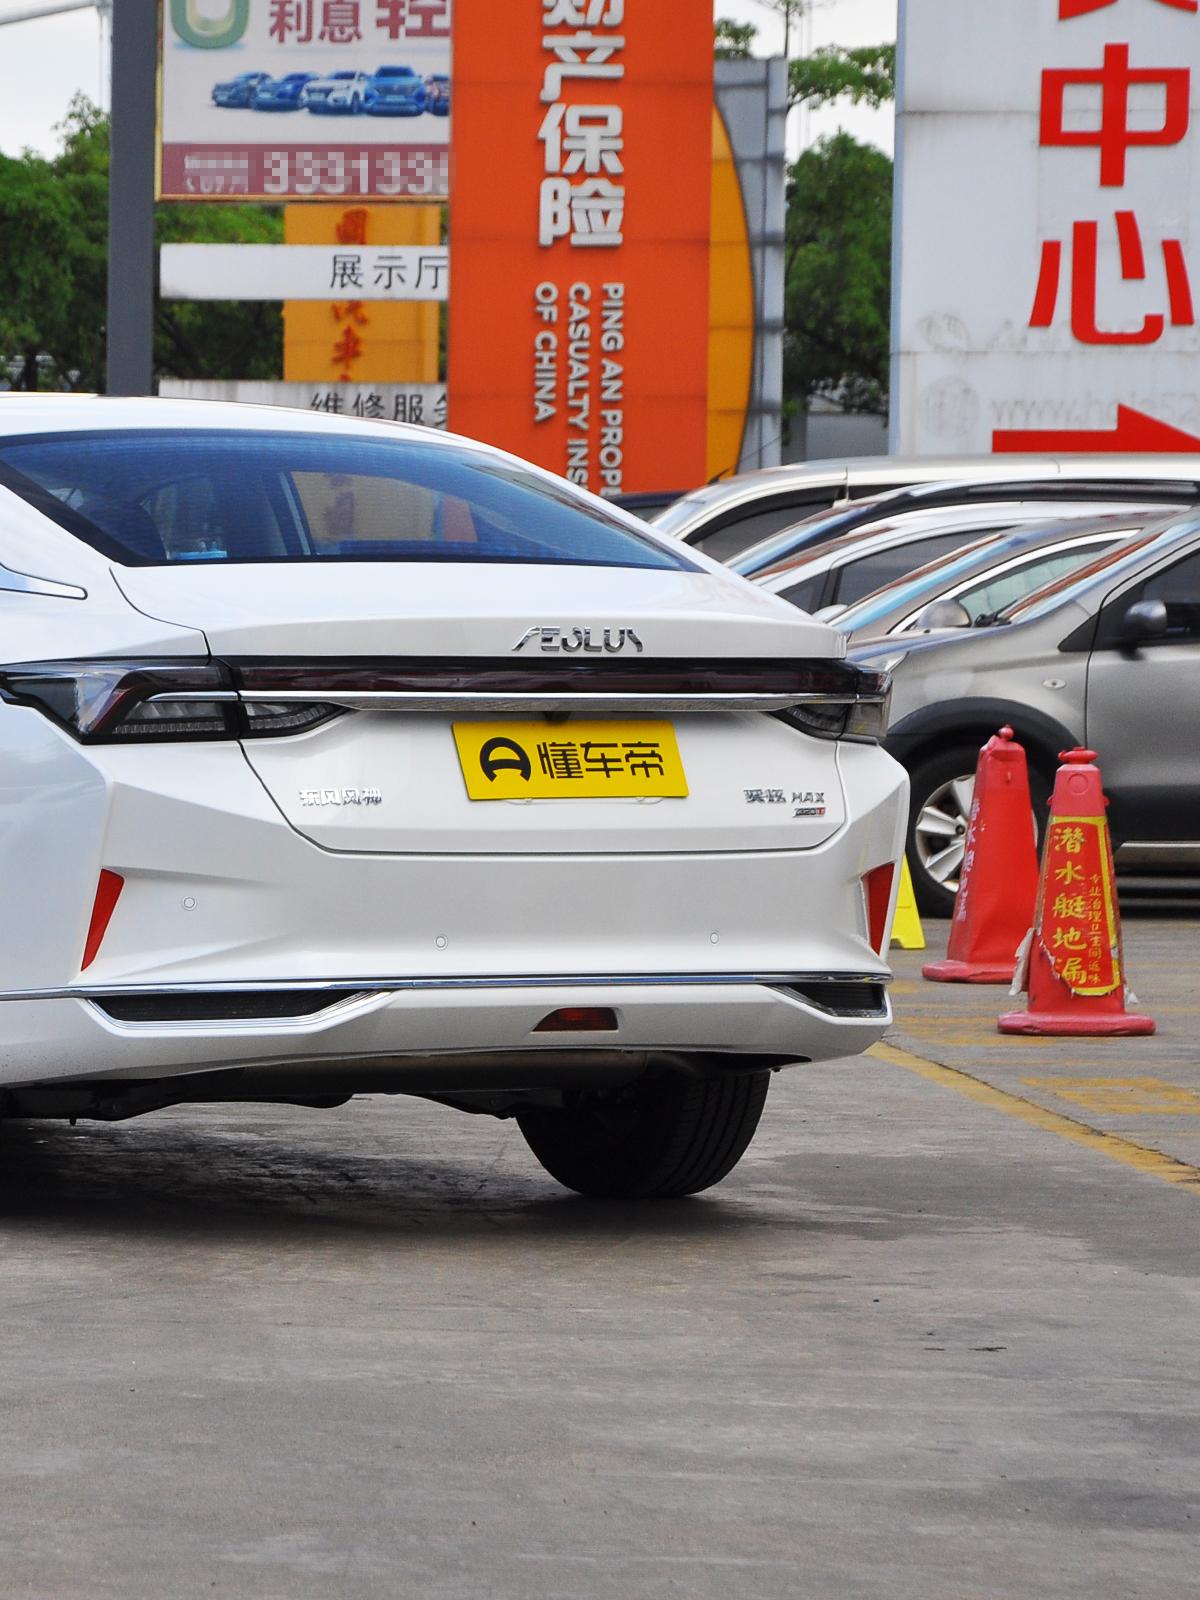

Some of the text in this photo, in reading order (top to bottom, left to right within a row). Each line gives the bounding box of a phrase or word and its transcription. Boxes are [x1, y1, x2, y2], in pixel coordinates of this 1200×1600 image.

[1029, 0, 1196, 346] 中心
[330, 254, 449, 290] 展示厅
[535, 281, 559, 422] OF CHINA
[601, 283, 624, 352] PING
[568, 281, 591, 431] CASUALTY
[601, 358, 624, 401] AN
[536, 741, 665, 780] 懂车帝
[791, 791, 825, 804] MAX
[1052, 827, 1089, 985] 潜水艇地漏
